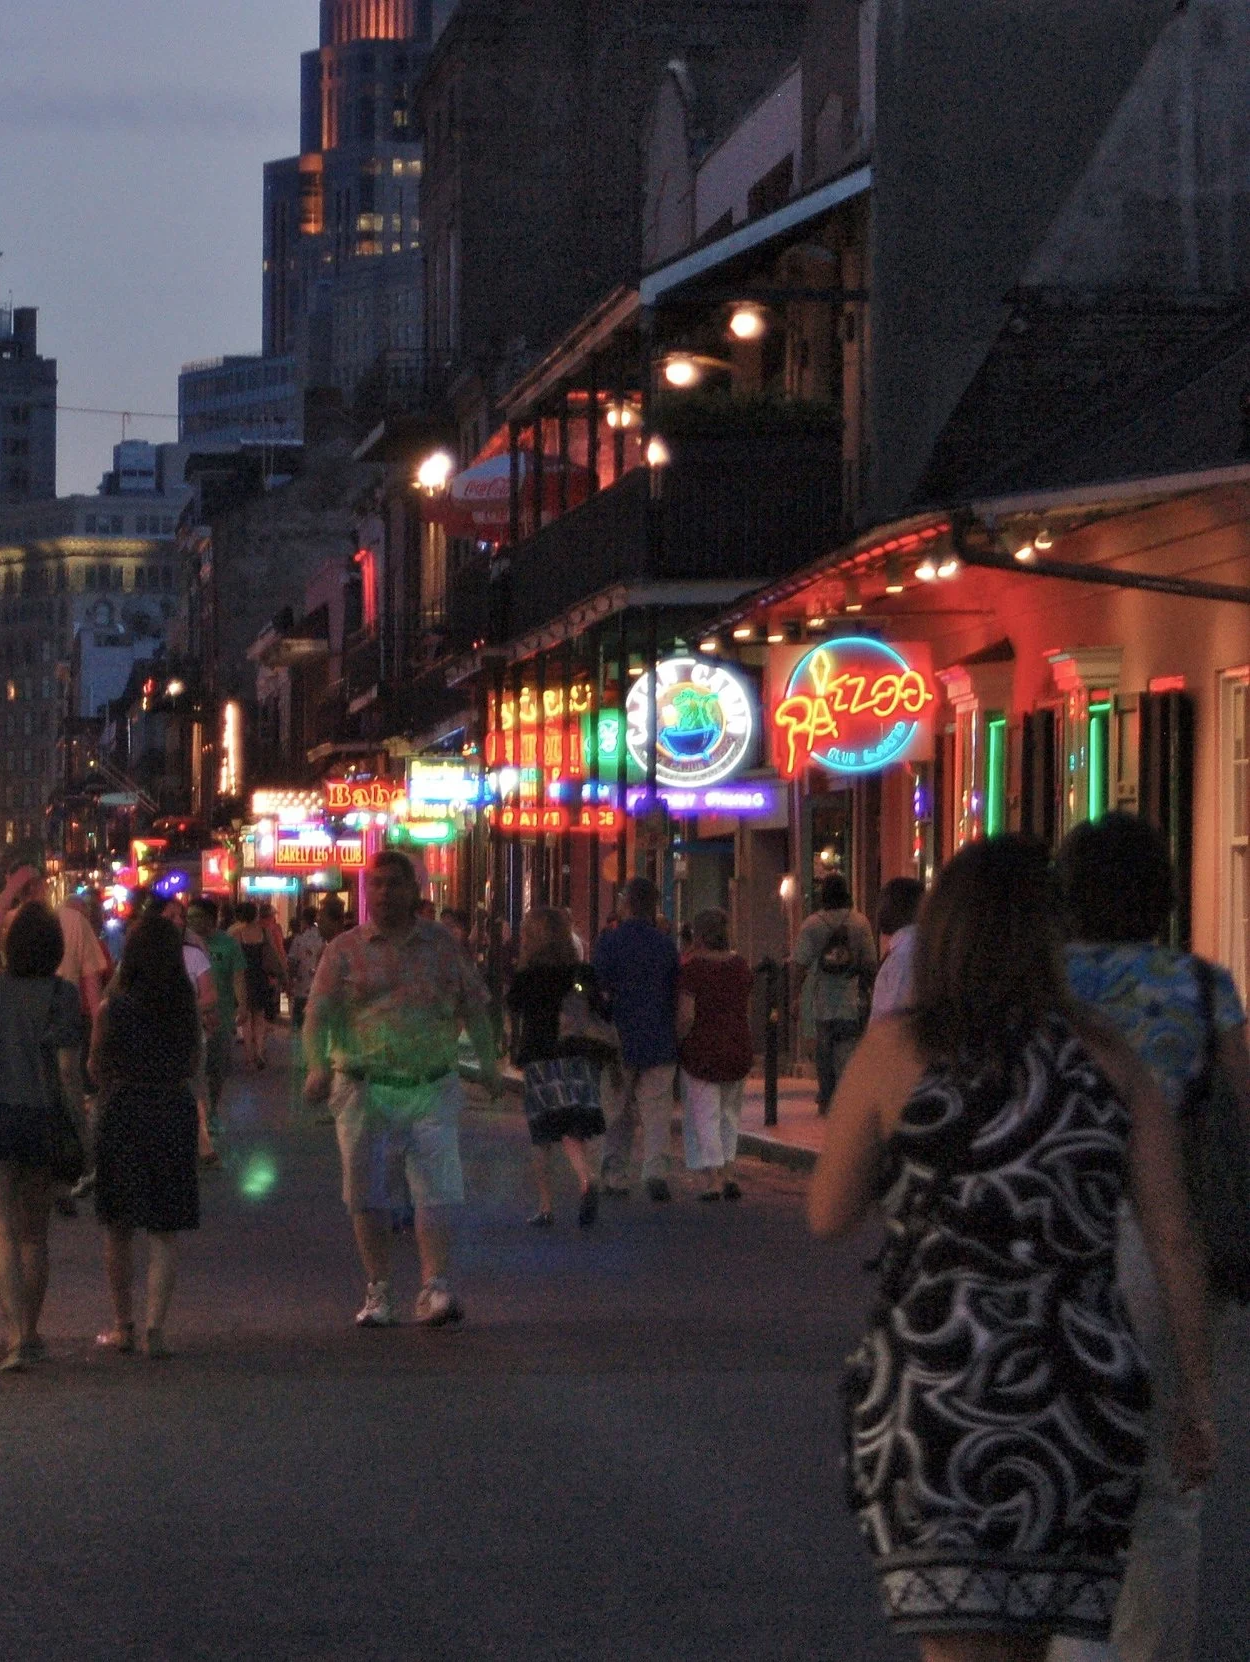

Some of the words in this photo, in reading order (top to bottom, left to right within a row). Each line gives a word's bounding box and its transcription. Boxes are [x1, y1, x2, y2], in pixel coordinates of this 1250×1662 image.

[625, 661, 679, 746] CAJN
[775, 668, 934, 773] RAZZOO
[277, 844, 310, 863] BARELY
[312, 844, 337, 863] LEGL
[340, 844, 362, 863] CLUB
